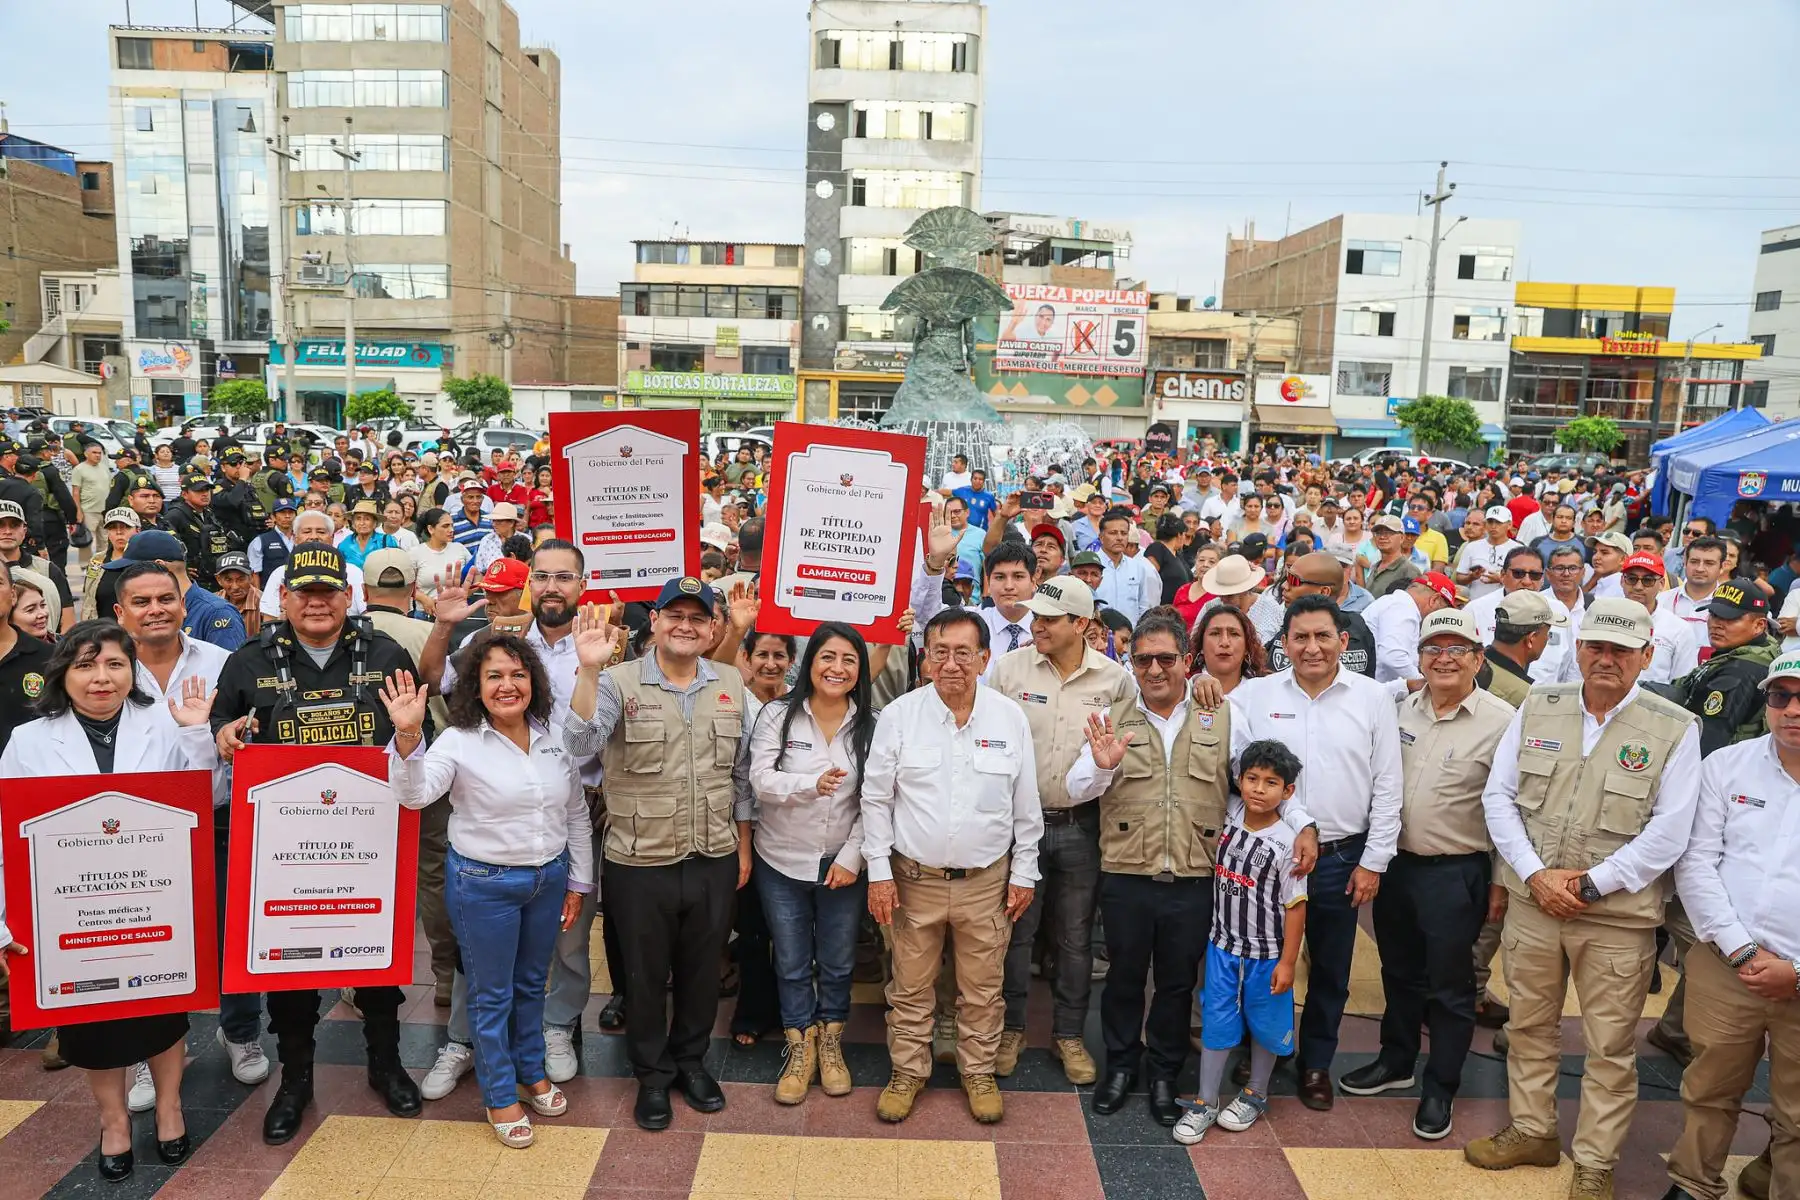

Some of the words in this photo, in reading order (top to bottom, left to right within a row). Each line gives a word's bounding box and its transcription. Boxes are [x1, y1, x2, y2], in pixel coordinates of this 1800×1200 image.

[1016, 223, 1062, 237] SAUNA
[1093, 228, 1132, 241] ROMA
[1006, 284, 1068, 301] FUERZA
[1072, 289, 1147, 305] POPULAR
[1113, 319, 1136, 357] 5
[1000, 341, 1028, 350] JAVIER
[1029, 342, 1061, 351] CASTRO
[1064, 363, 1099, 372] MERECE
[643, 375, 701, 390] BOTICAS
[704, 376, 782, 392] FORTALEZA
[1163, 373, 1245, 401] chanis
[588, 459, 628, 468] Gobierno
[630, 458, 643, 466] del
[645, 457, 664, 466] Perú
[603, 485, 638, 494] TÍTULOS
[806, 484, 846, 496] Gobierno
[848, 489, 862, 498] del
[864, 490, 884, 500] Perú
[1781, 479, 1800, 493] MU
[586, 493, 637, 503] AFECTACIÓN
[592, 514, 618, 522] Colegios
[625, 512, 664, 520] Instituciones
[821, 515, 863, 530] TÍTULO
[611, 520, 645, 528] Educativas
[634, 532, 672, 540] EDUCACIÓN
[800, 527, 815, 538] DE
[818, 529, 882, 544] PROPIEDAD
[803, 541, 876, 557] REGISTRADO
[221, 556, 244, 567] UFC
[294, 550, 340, 572] POLICIA
[648, 566, 679, 574] COFOPRI
[802, 567, 871, 582] LAMBAYEQUE
[853, 592, 887, 602] COFOPRI
[1430, 617, 1463, 628] MINEDU
[1596, 615, 1634, 628] MINDEF
[302, 725, 355, 744] POLICIA
[279, 807, 329, 816] Gobierno
[332, 806, 348, 816] del
[351, 806, 376, 816] Perú
[57, 837, 113, 849] Gobierno
[117, 833, 134, 845] del
[138, 832, 164, 844] Perú
[298, 840, 337, 850] TÍTULO
[340, 842, 355, 850] DE
[272, 850, 338, 860] AFECTACIÓN
[341, 852, 355, 860] EN
[358, 851, 378, 860] USO
[78, 871, 129, 882] TÍTULOS
[132, 869, 148, 879] DE
[54, 880, 127, 895] AFECTACIÓN
[131, 880, 146, 889] EN
[149, 878, 172, 888] USO
[293, 886, 334, 895] Comisaría
[336, 886, 355, 895] PNP
[78, 908, 105, 917] Postas
[108, 905, 143, 915] médicas
[146, 905, 152, 913] y
[269, 903, 318, 912] MINISTERIO
[319, 903, 336, 911] DEL
[337, 902, 376, 910] INTERIOR
[78, 917, 113, 928] Centros
[115, 916, 126, 925] de
[128, 914, 152, 924] salud
[65, 933, 119, 945] MINISTERIO
[121, 933, 134, 941] DE
[135, 929, 166, 940] SALUD
[344, 946, 385, 955] COFOPRI
[143, 972, 187, 983] COFOPRI
